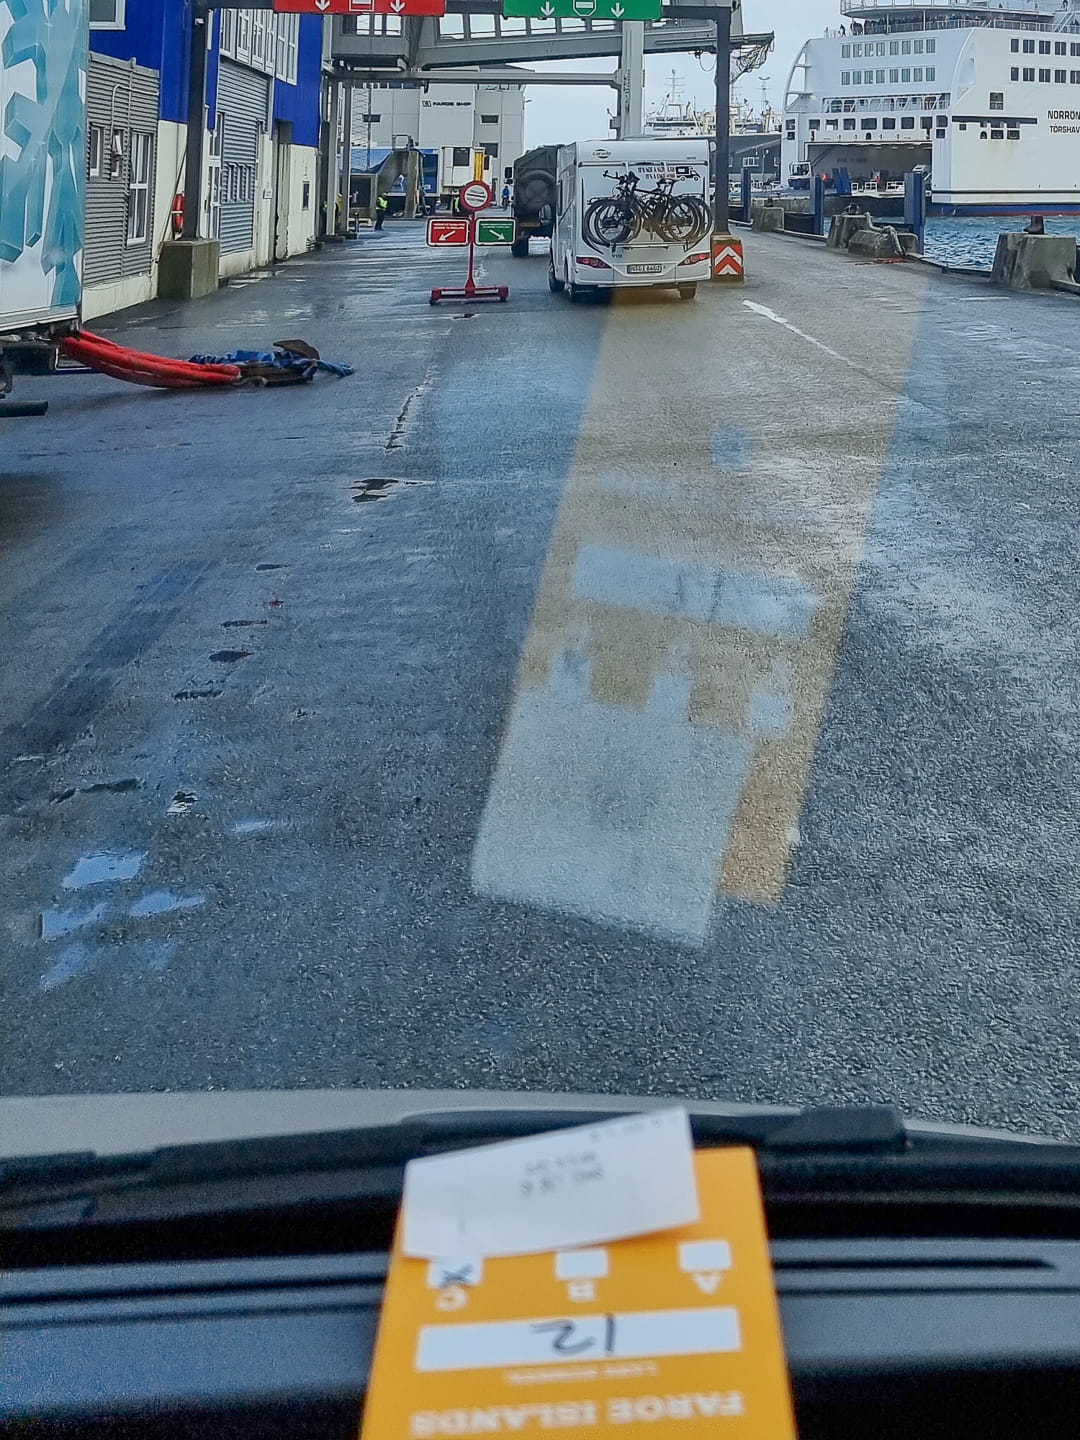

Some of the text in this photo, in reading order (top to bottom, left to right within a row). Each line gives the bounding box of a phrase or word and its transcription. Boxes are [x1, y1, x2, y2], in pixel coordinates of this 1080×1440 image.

[435, 1272, 722, 1312] A B C
[529, 1313, 617, 1355] 12
[410, 1390, 745, 1438] FAROE ISLANDS
